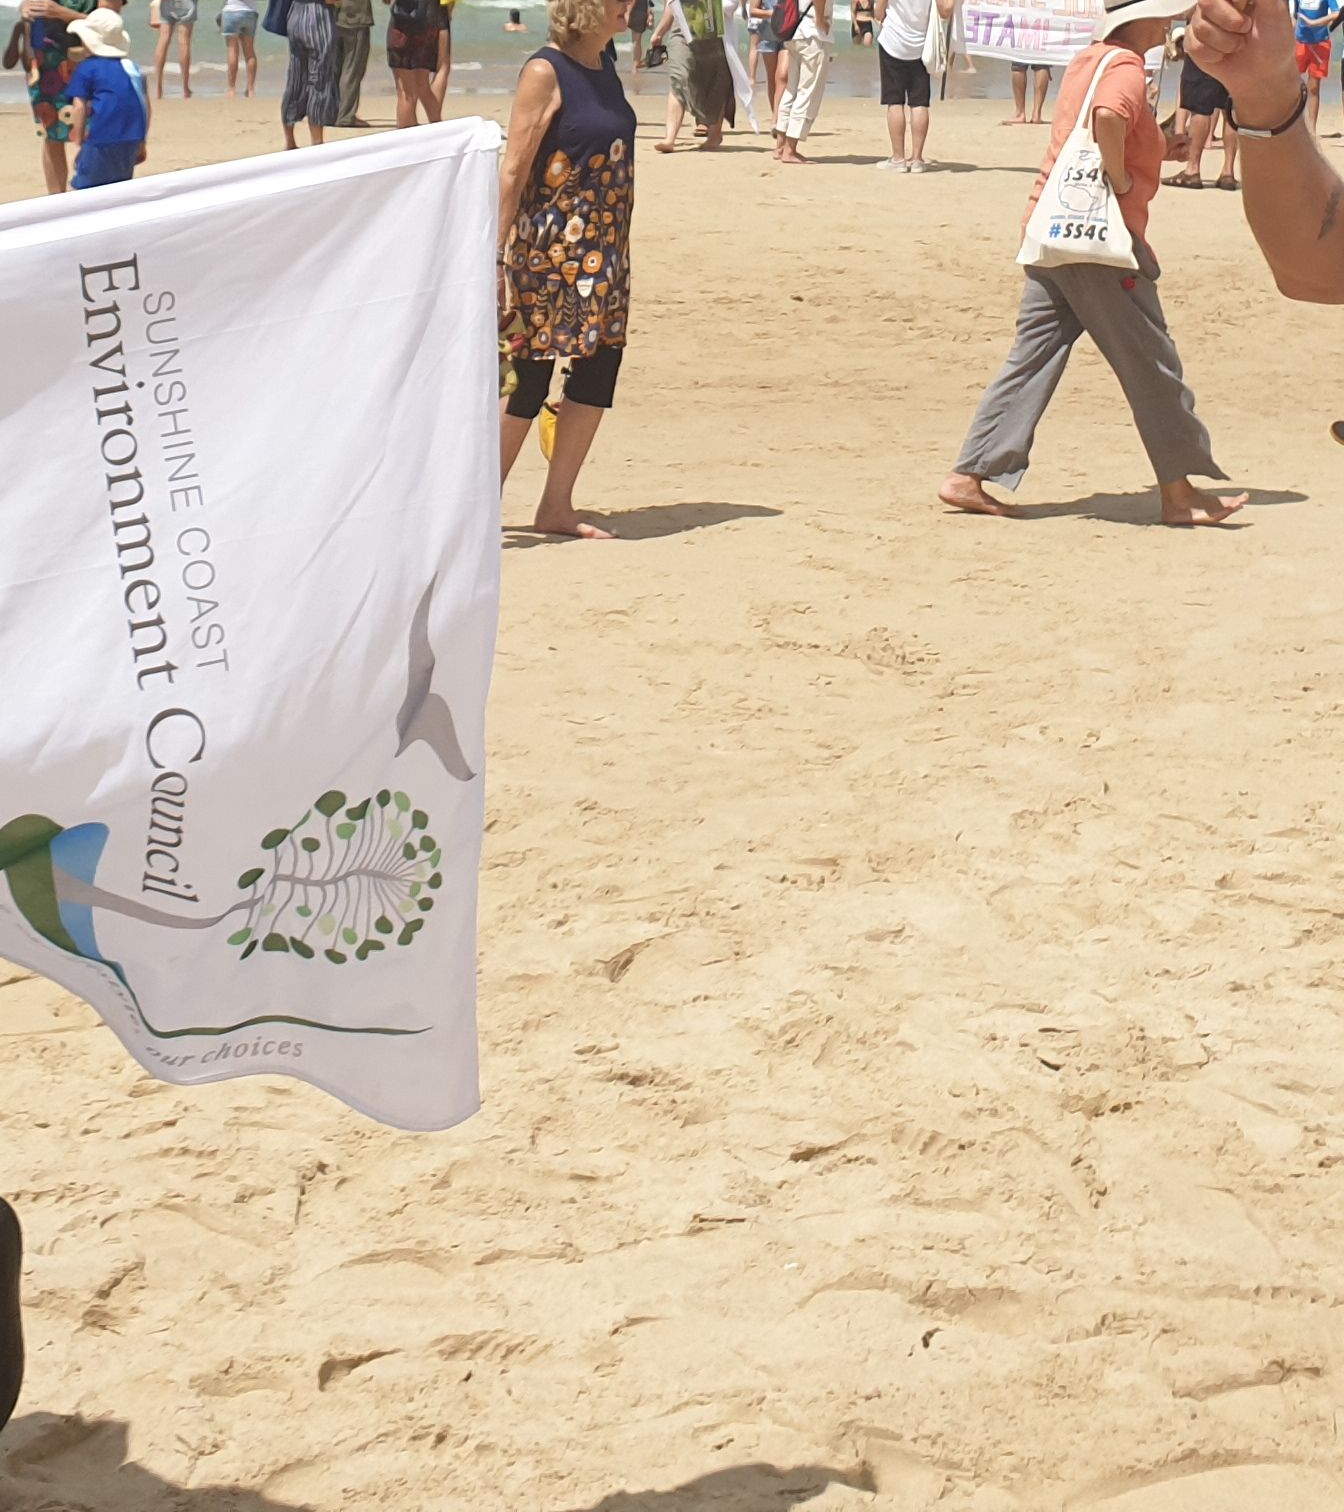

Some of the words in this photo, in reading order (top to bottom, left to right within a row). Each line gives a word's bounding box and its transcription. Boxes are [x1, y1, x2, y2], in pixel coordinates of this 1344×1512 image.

[78, 252, 179, 692] Environment
[141, 708, 207, 904] Council
[143, 290, 204, 513] SUNSHINE
[176, 526, 230, 673] COAST
[201, 1035, 305, 1065] choices
